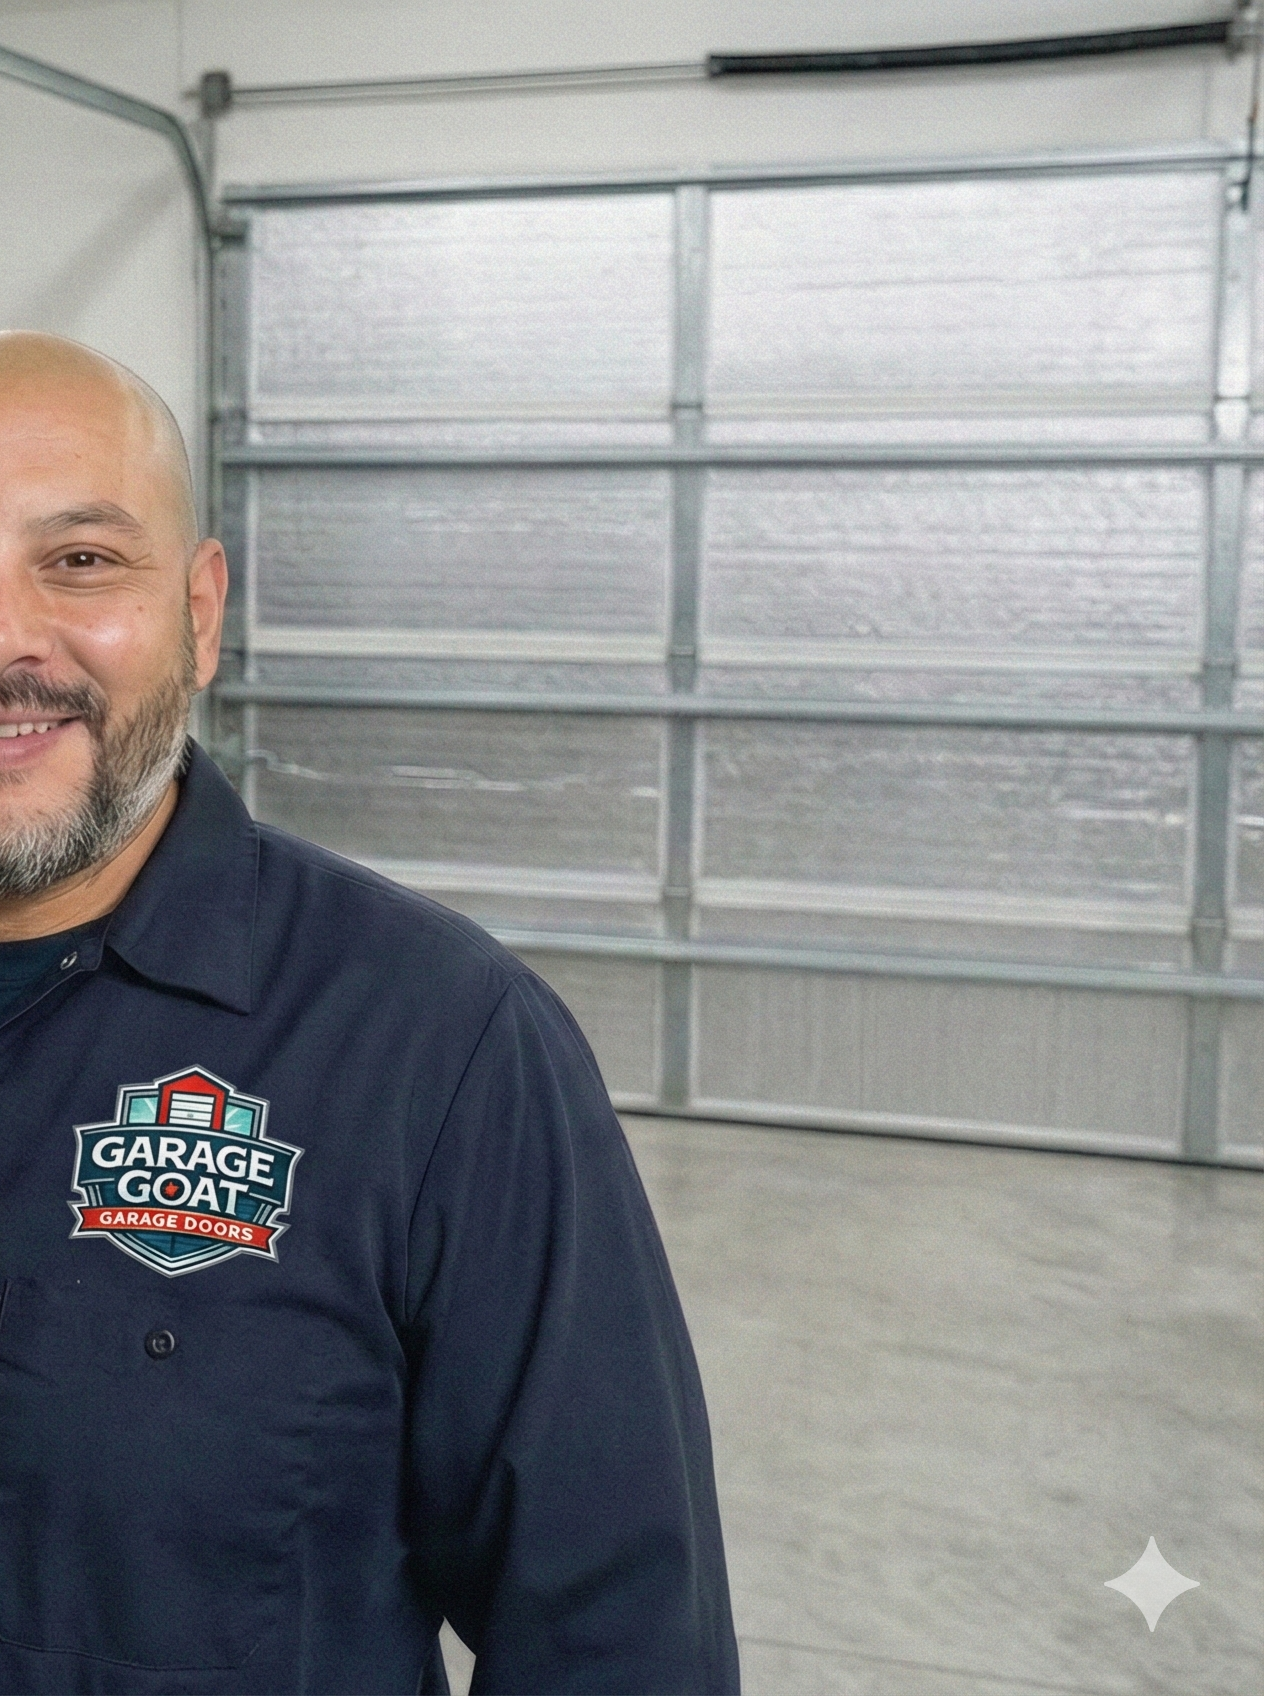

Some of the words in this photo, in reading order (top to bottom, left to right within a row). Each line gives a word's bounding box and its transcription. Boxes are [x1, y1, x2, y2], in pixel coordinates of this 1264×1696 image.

[91, 1136, 275, 1187] GARAGE
[117, 1169, 250, 1216] GOAT
[99, 1211, 178, 1229] GARAGE
[184, 1216, 254, 1241] DOORS
